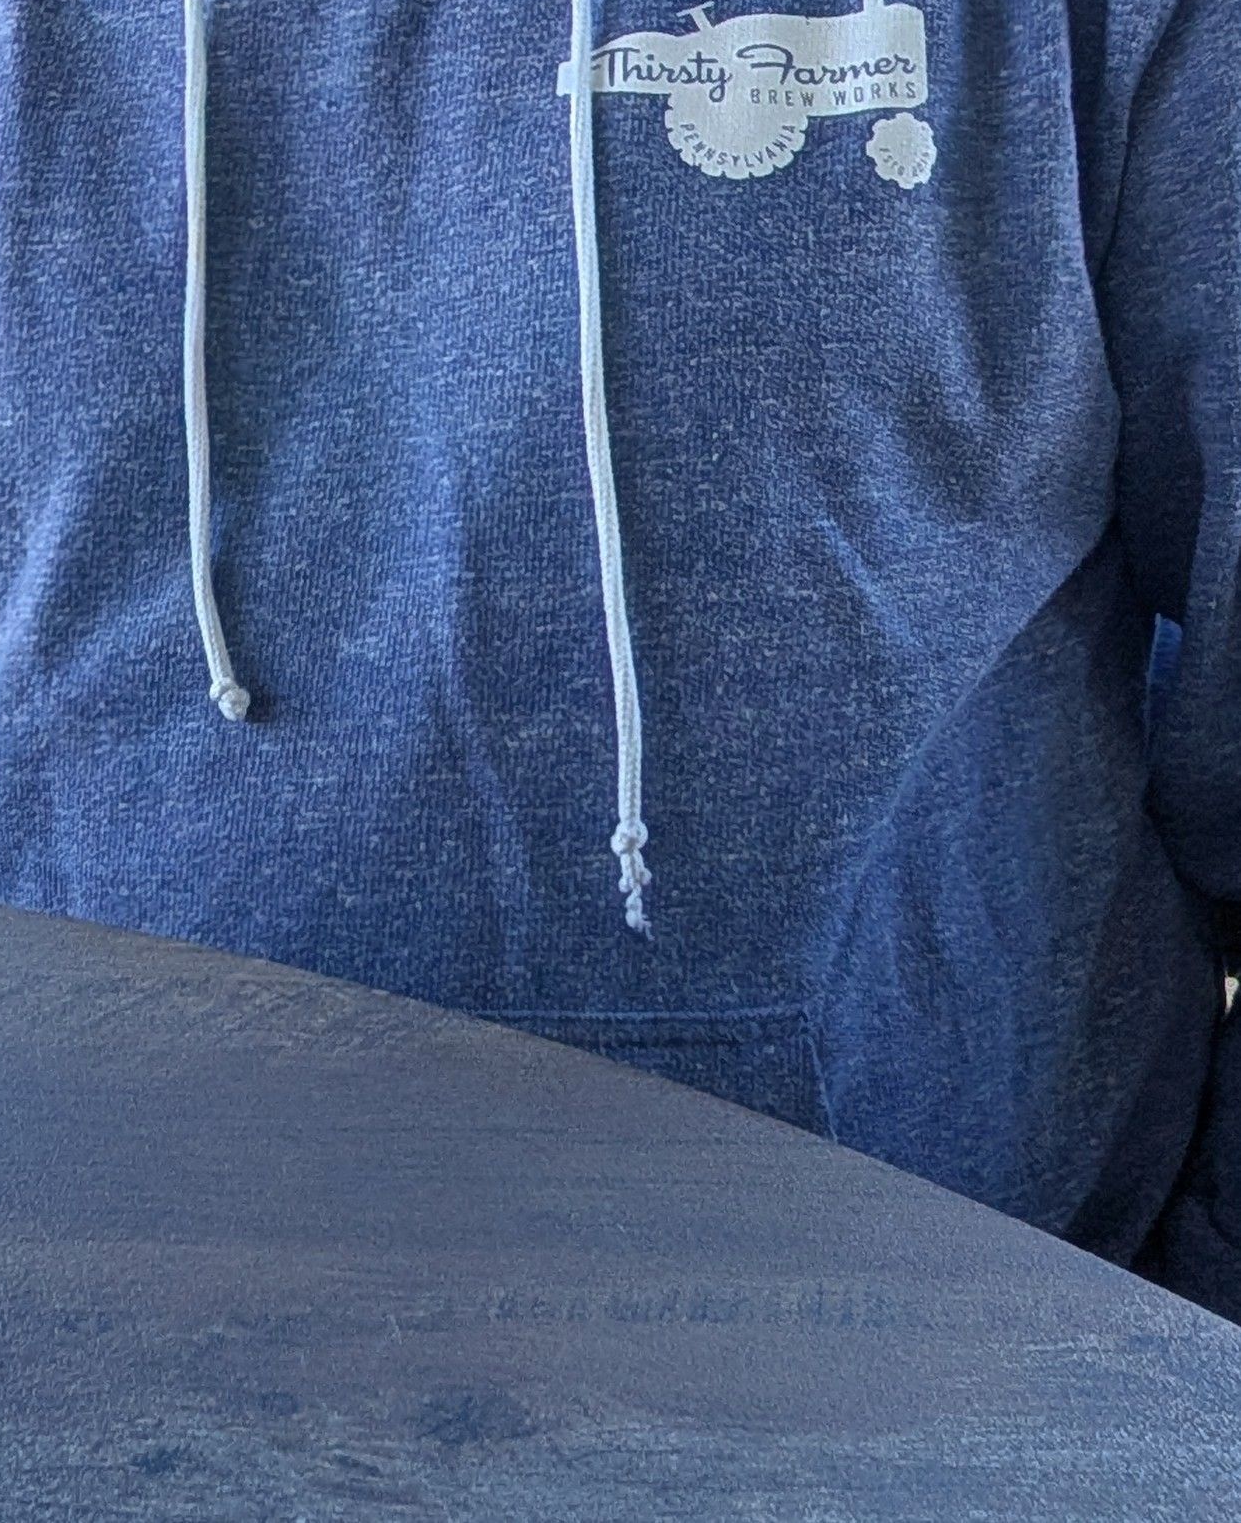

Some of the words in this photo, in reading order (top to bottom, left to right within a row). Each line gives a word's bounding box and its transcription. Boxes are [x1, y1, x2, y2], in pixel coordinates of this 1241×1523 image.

[590, 47, 733, 102] Thirsty
[736, 43, 916, 85] Farmer
[750, 88, 814, 107] BREW
[833, 82, 916, 106] WORKS
[679, 122, 797, 169] PENNSYLVANIA
